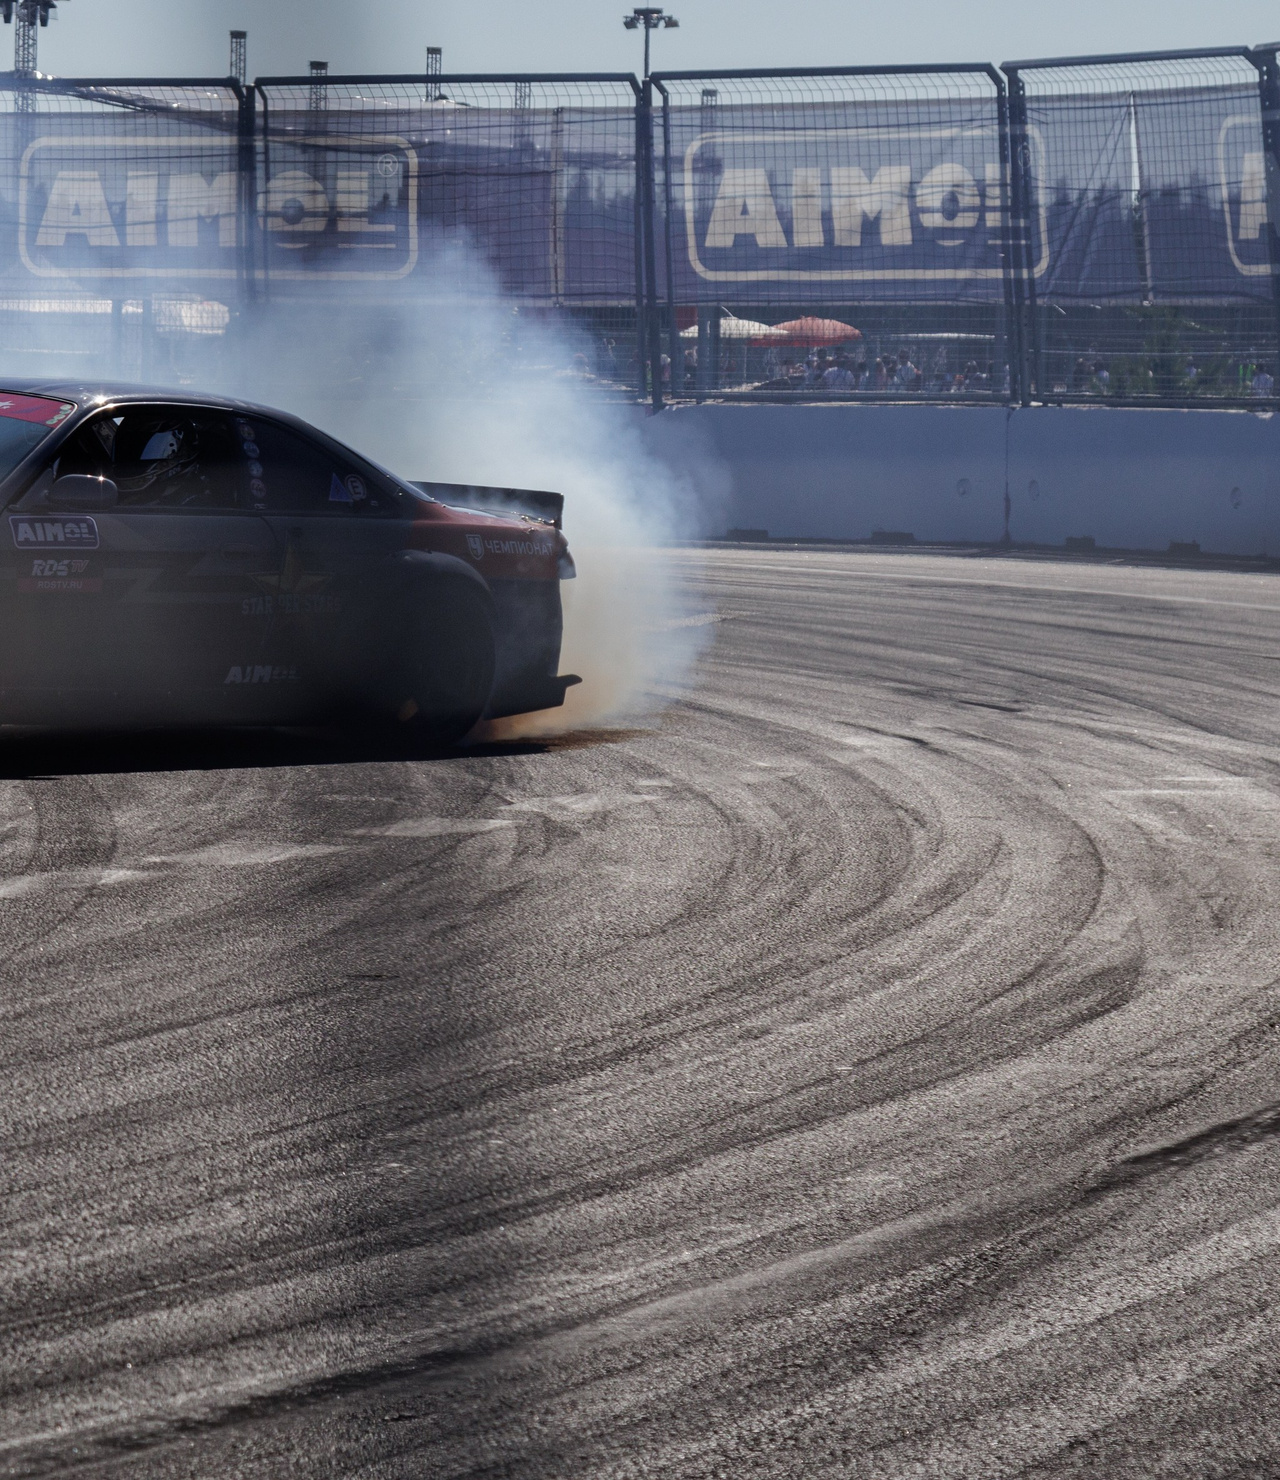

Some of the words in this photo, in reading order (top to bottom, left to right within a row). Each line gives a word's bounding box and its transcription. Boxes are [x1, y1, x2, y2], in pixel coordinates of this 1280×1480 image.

[34, 170, 397, 248] AIMOL
[17, 522, 96, 542] AIMOL
[484, 539, 553, 556] ЧЕМПИОНАТ
[37, 580, 83, 590] RDSTV.RU
